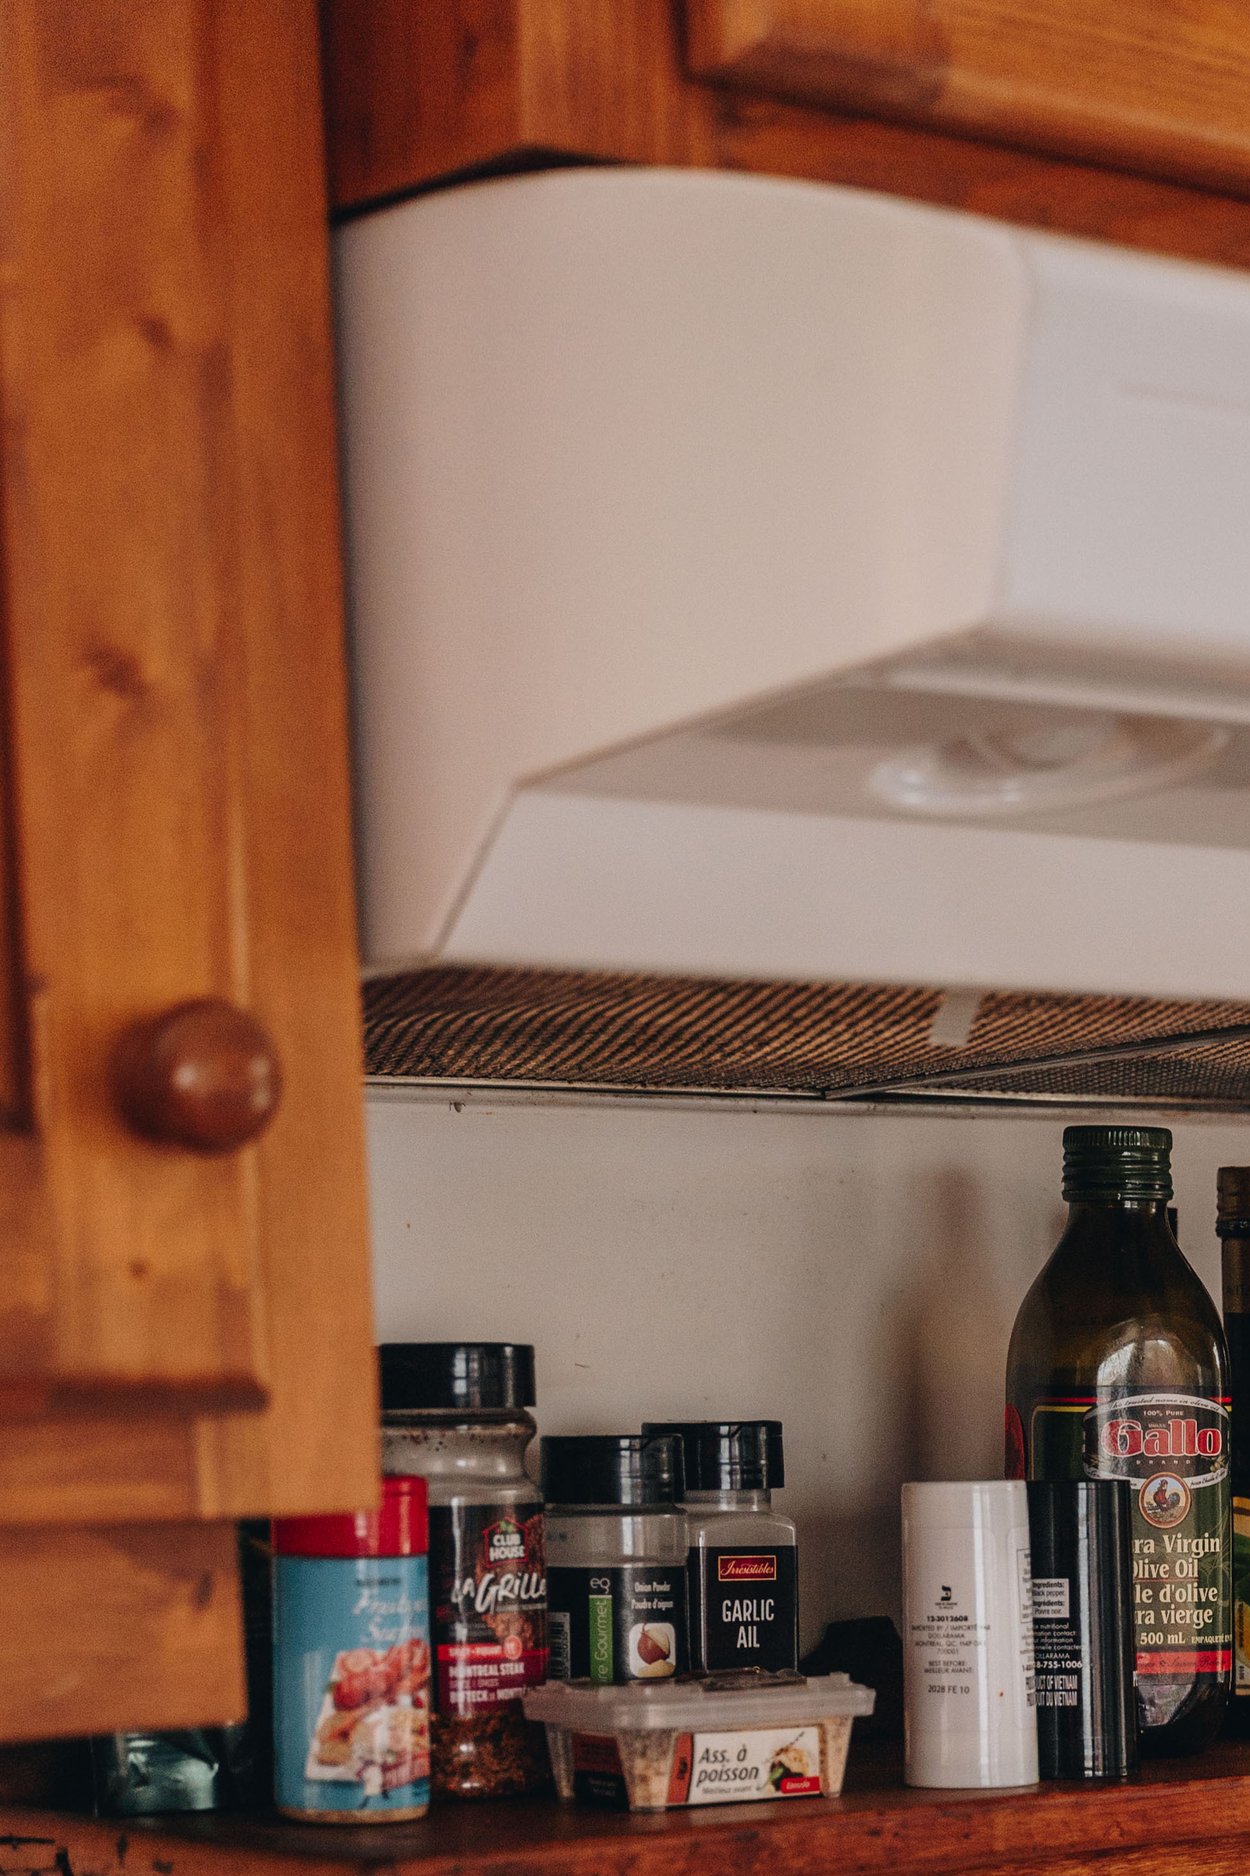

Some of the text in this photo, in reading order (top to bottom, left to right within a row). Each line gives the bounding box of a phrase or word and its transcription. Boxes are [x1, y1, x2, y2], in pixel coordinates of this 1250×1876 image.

[1101, 1418, 1222, 1458] Gallo
[493, 1533, 521, 1546] CLUB
[1162, 1532, 1221, 1559] Virgin
[489, 1545, 526, 1562] HOUSE
[1175, 1558, 1199, 1578] Oil
[1159, 1582, 1218, 1603] d'olive
[722, 1598, 775, 1622] GARLIC
[1161, 1603, 1213, 1629] vierge
[594, 1600, 608, 1661] Gourmet
[736, 1625, 760, 1648] AIL
[1140, 1632, 1186, 1645] 500 mL
[500, 1662, 525, 1676] STEAK
[928, 1684, 970, 1694] 2028 FE 10
[1054, 1675, 1078, 1690] VIETNAM
[1054, 1691, 1078, 1706] VIETNAM
[699, 1744, 748, 1764] Ass. à
[696, 1764, 760, 1788] poisson
